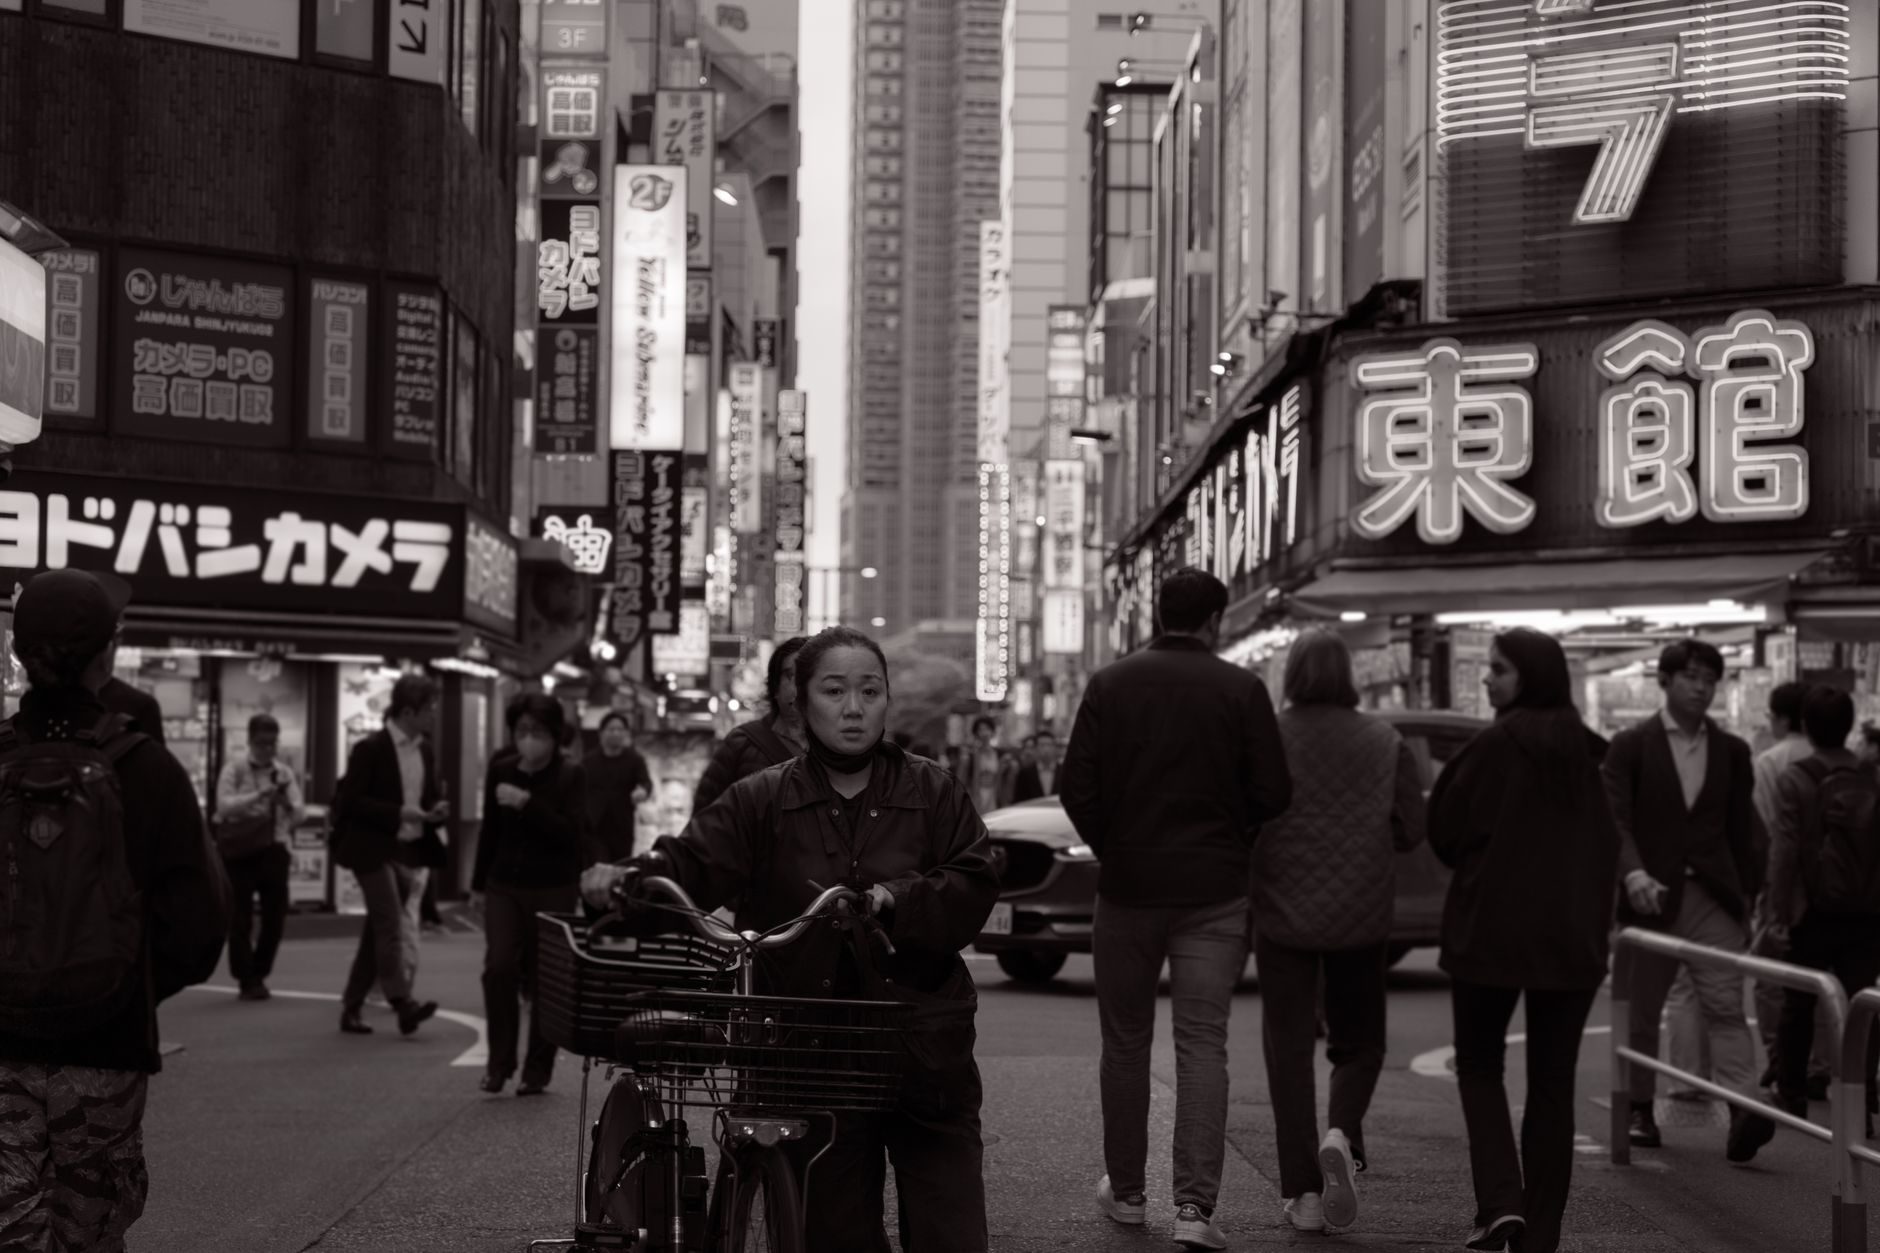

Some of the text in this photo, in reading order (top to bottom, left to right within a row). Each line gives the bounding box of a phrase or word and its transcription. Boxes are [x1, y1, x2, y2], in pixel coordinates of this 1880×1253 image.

[558, 27, 588, 48] 3F
[629, 174, 673, 211] 2F
[538, 238, 570, 319] カメラ
[568, 204, 599, 312] ヨドバシ
[638, 256, 657, 318] Yellow
[135, 309, 191, 328] JANPARA
[160, 273, 285, 320] じゃんぱら
[132, 374, 273, 425] 高価買取
[1353, 308, 1815, 545] 東館
[0, 490, 453, 594] ヨドバシカメラ
[614, 451, 645, 644] ヨドバシカメラ
